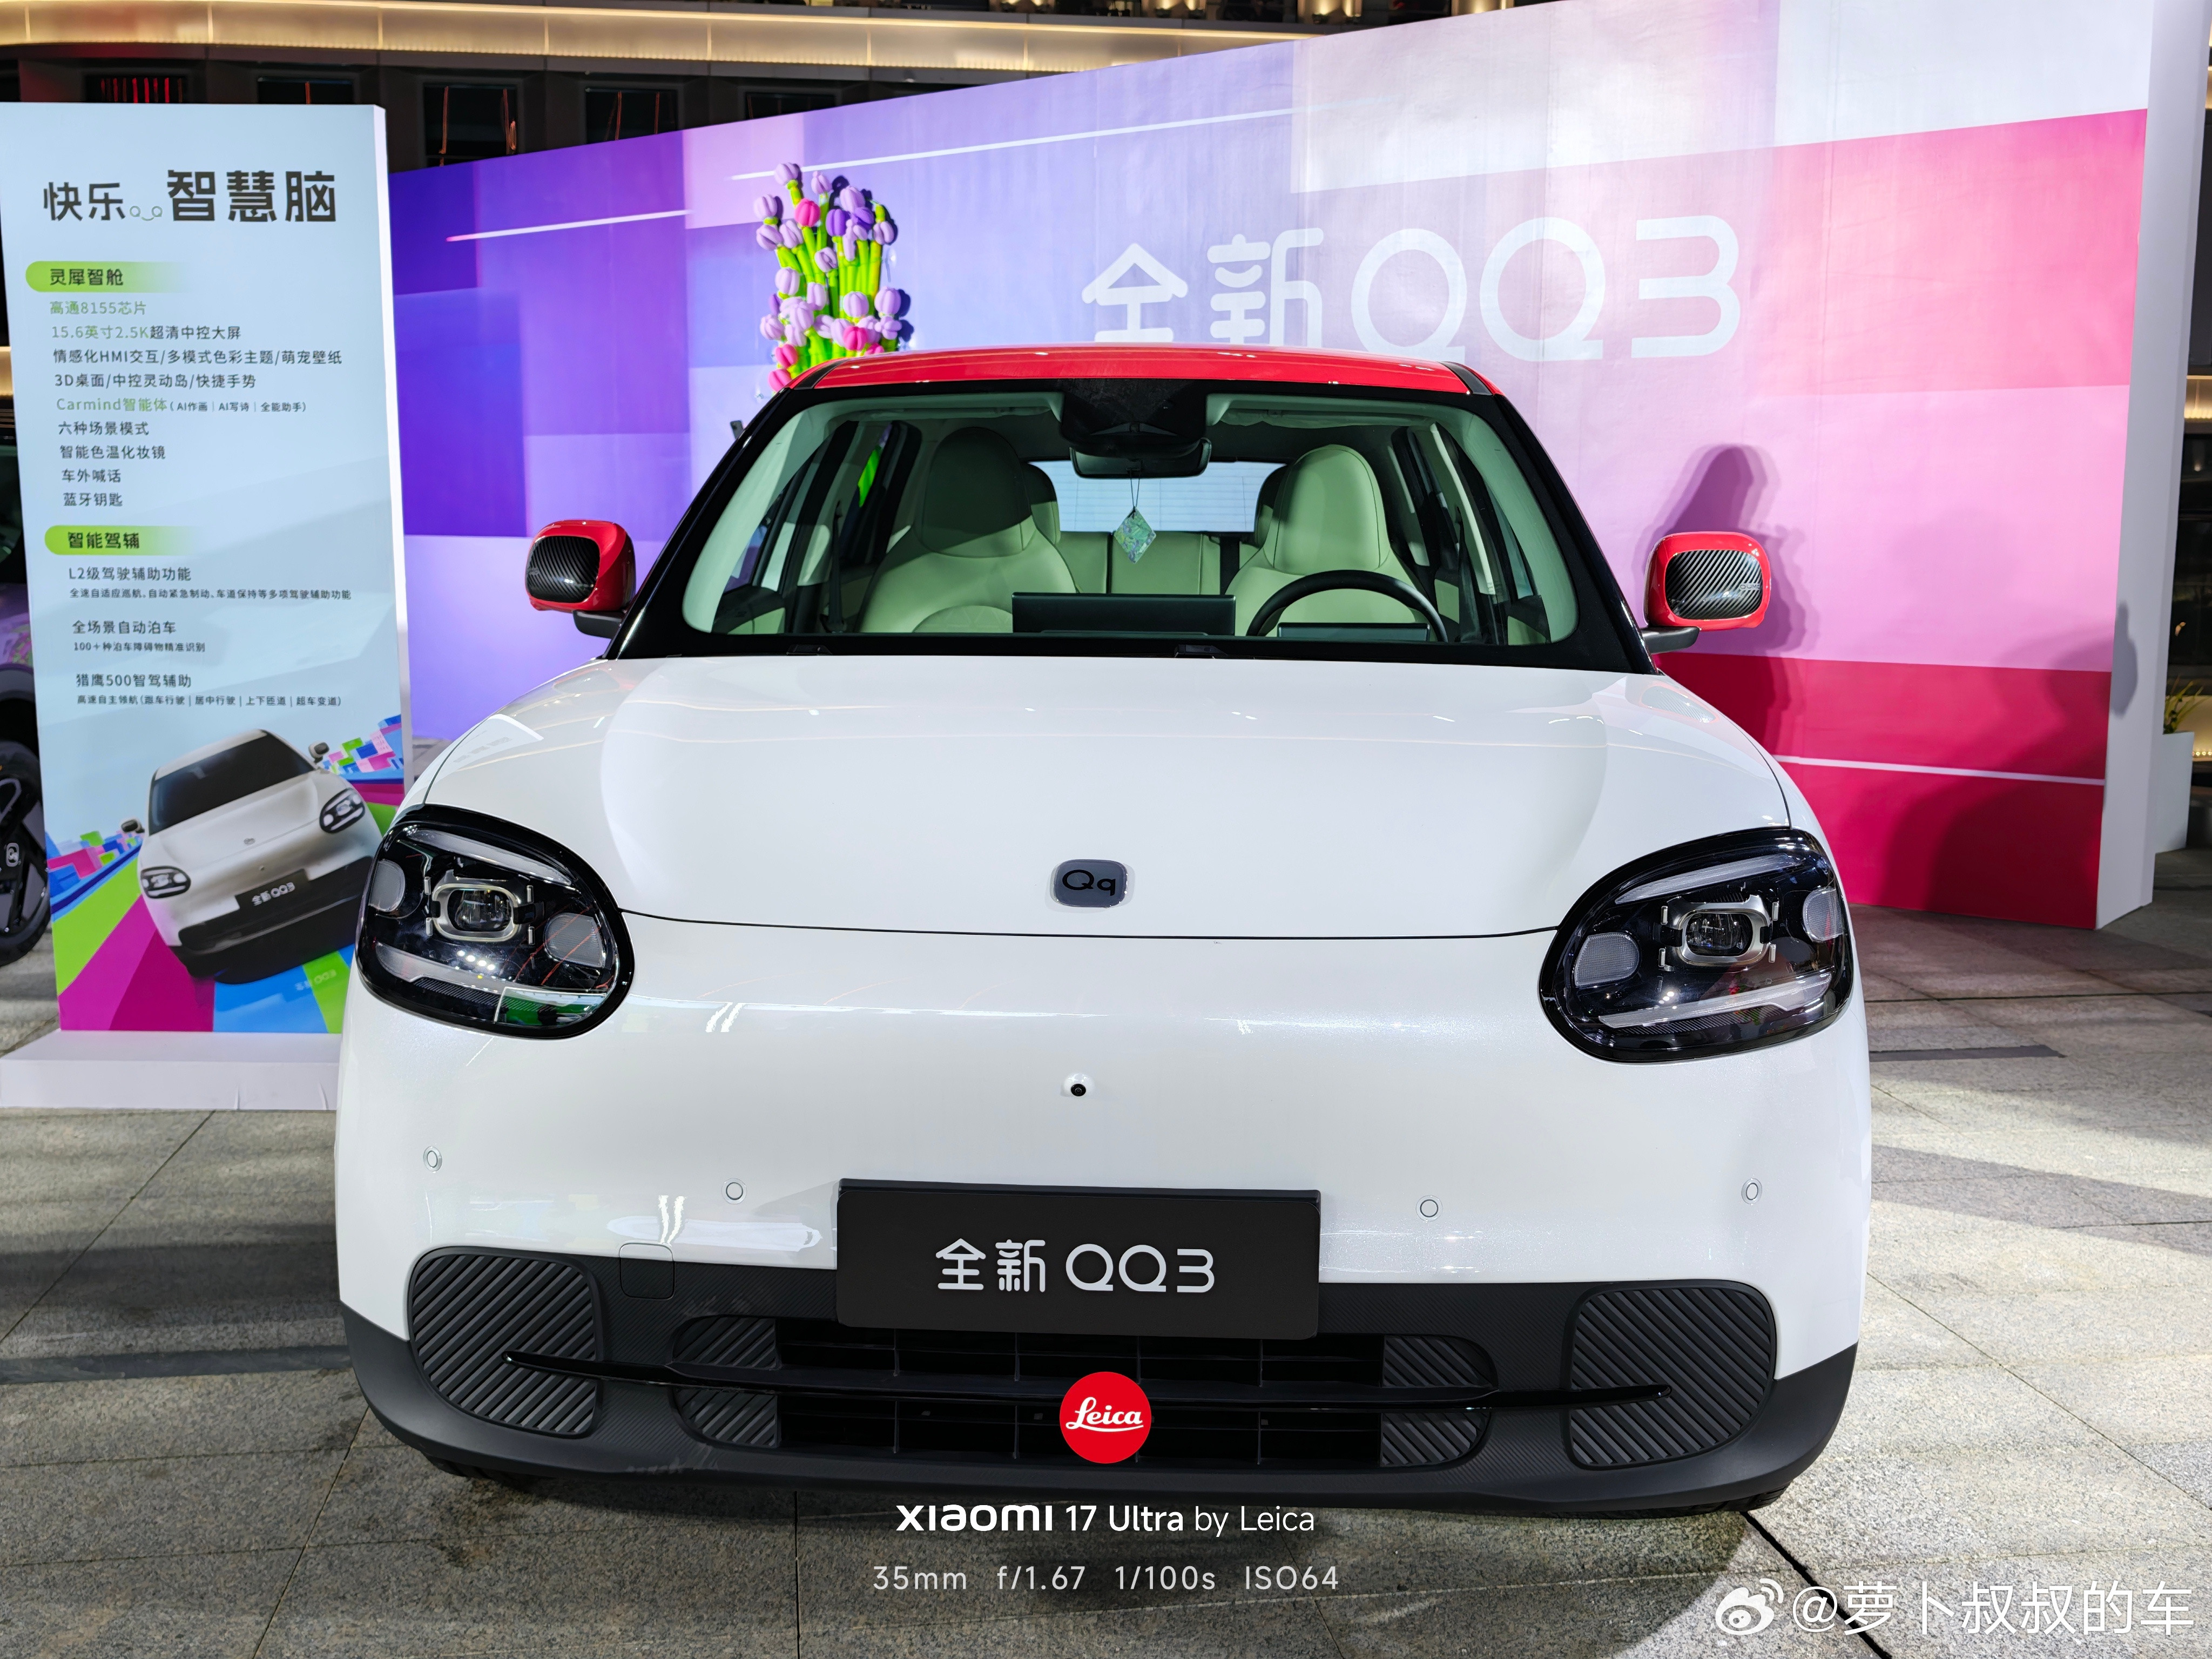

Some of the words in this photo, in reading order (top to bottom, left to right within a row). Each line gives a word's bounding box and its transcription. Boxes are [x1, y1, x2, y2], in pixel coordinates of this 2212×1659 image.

[43, 182, 125, 221] 快乐
[167, 170, 336, 222] 智慧脑
[50, 268, 124, 286] 灵犀智舱
[1351, 215, 1741, 363] QQ3
[50, 301, 146, 315] 高通8155芯片
[52, 325, 241, 340] 15.6英寸2.5K超清中控大屏
[53, 349, 342, 365] 情感化HMI交互/多模式色彩主题/萌宠壁纸
[55, 374, 256, 389] 3D桌面/中控灵动岛/快捷手势
[58, 421, 149, 436] 六种场景模式
[60, 445, 166, 460] 智能色温化妆镜
[62, 469, 121, 483] 车外喊话
[63, 492, 123, 507] 蓝牙钥匙
[68, 531, 140, 550] 智能驾辅
[69, 567, 191, 582] L2级驾驶辅助功能
[72, 620, 176, 635] 全场景自动泊车
[76, 673, 192, 688] 猎鹰500智驾辅助
[1062, 869, 1116, 896] Qq
[935, 1238, 1046, 1292] 全新
[1065, 1244, 1215, 1293] QQ3
